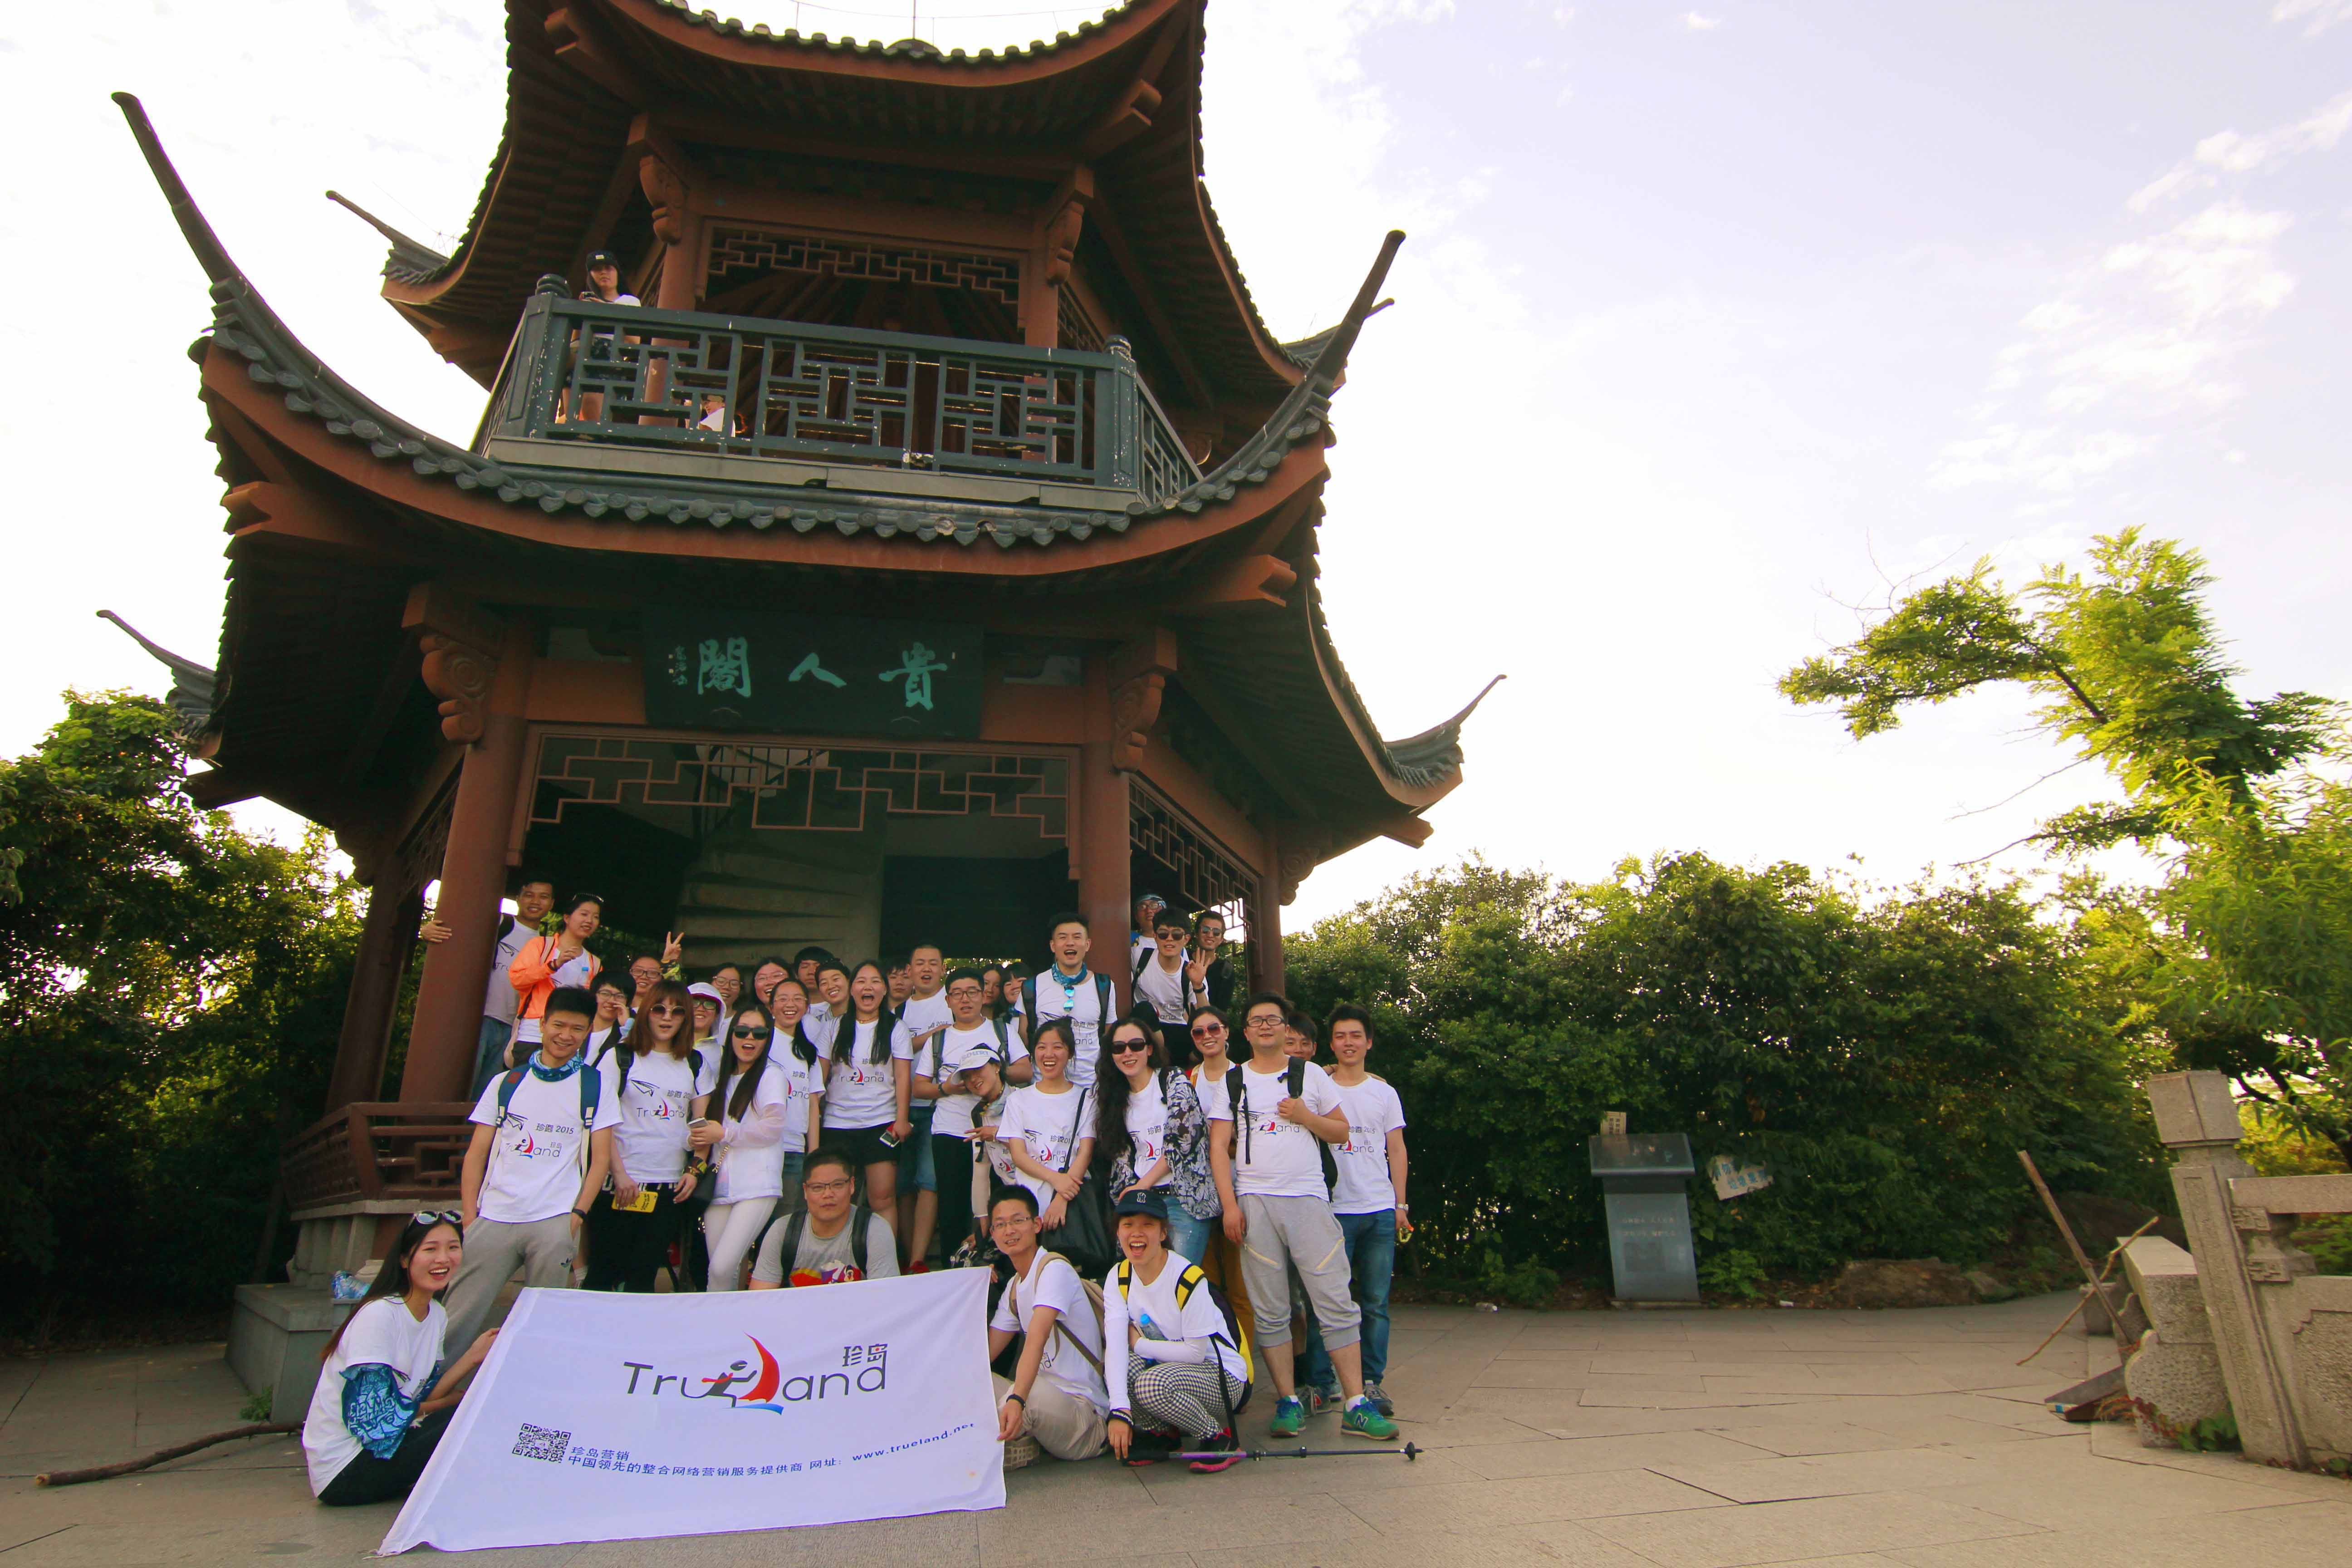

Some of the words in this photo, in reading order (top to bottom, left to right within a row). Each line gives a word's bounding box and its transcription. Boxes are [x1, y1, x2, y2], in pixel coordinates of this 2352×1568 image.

[555, 1125, 574, 1135] 2015
[842, 1343, 888, 1367] 珍岛
[1354, 1412, 1369, 1429] N
[570, 1446, 630, 1461] 珍岛营销
